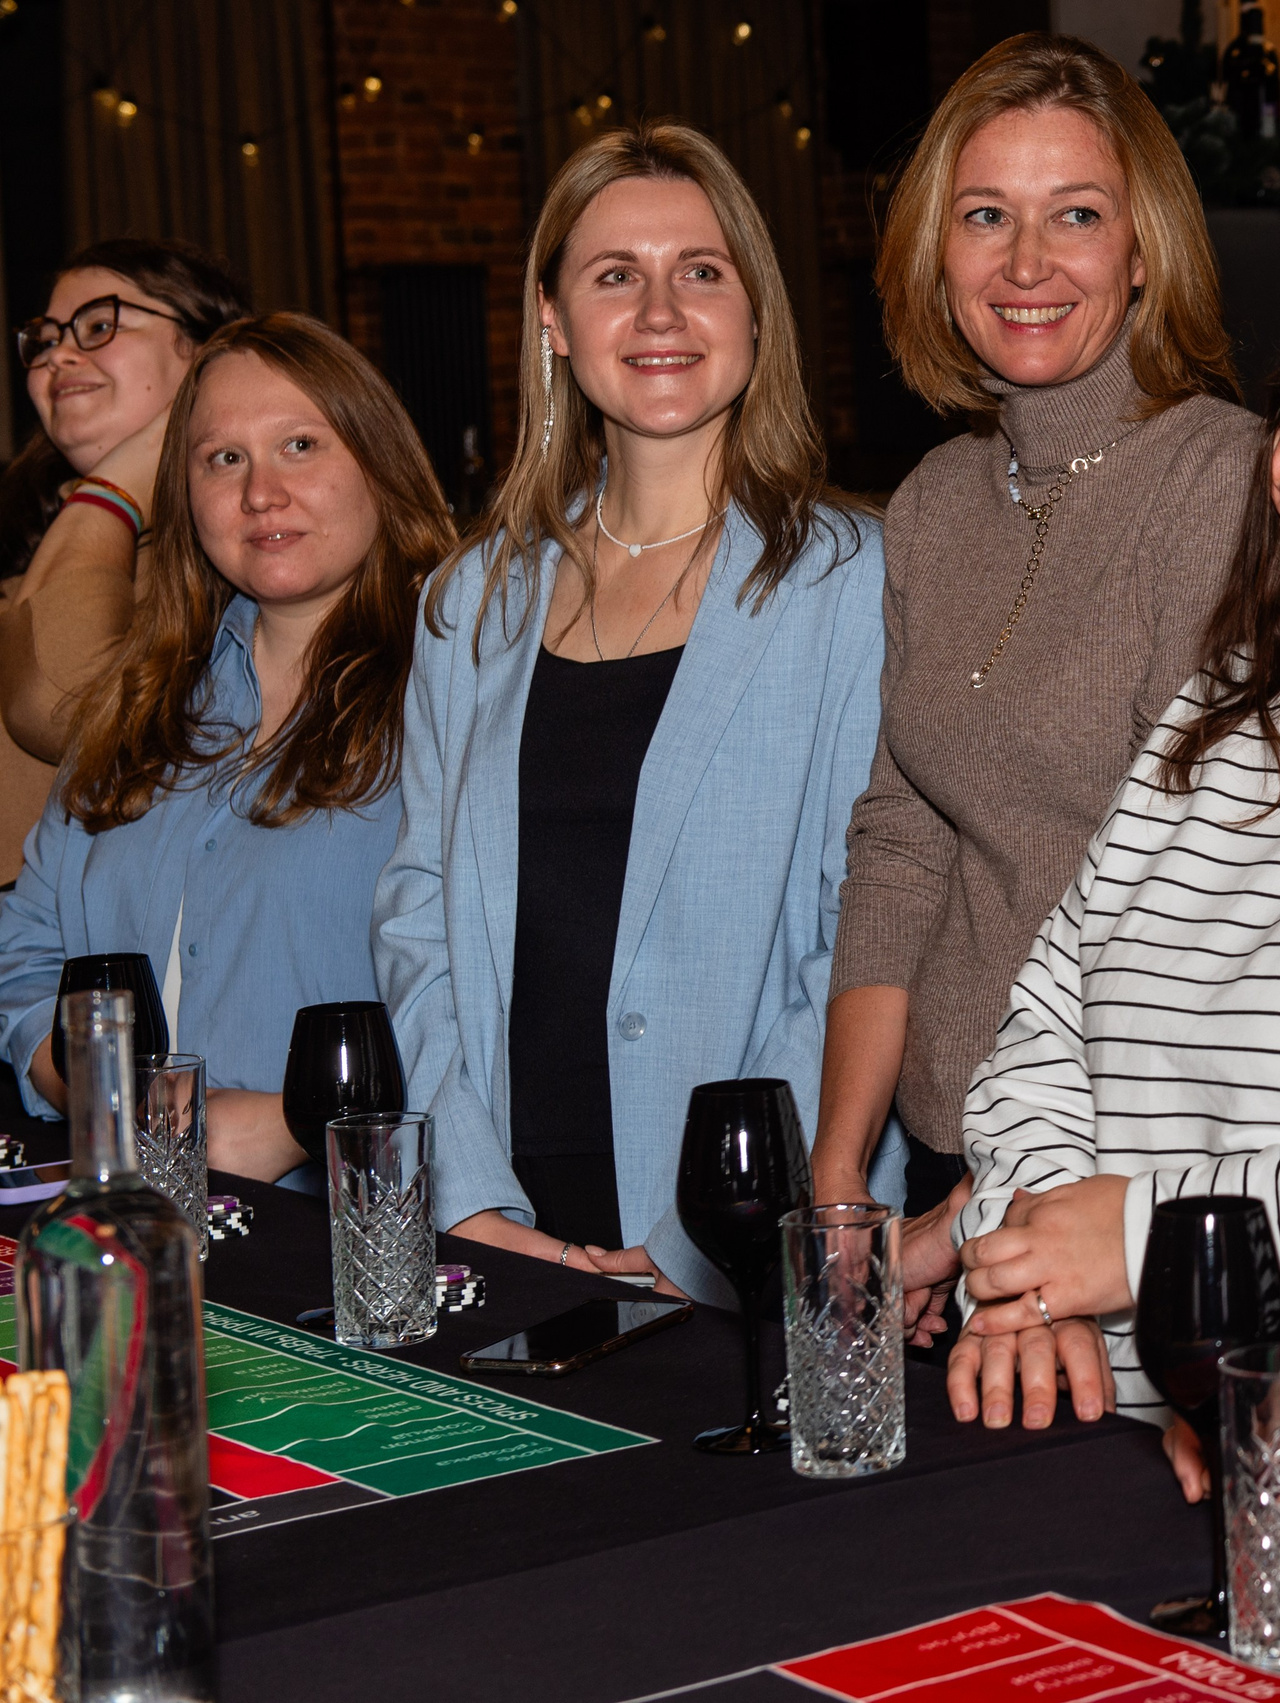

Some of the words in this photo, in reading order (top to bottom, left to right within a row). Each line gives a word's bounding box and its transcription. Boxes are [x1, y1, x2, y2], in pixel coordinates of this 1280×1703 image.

[264, 1333, 341, 1360] ТРАВЫ
[249, 1366, 301, 1379] mint
[341, 1359, 422, 1384] HERBS
[407, 1376, 466, 1397] AND
[354, 1400, 408, 1415] анис
[364, 1404, 421, 1420] anise
[452, 1392, 539, 1421] SPICES
[380, 1424, 486, 1450] cinnamon
[391, 1420, 471, 1441] корица
[436, 1442, 537, 1467] гвоздика
[496, 1446, 554, 1462] clove
